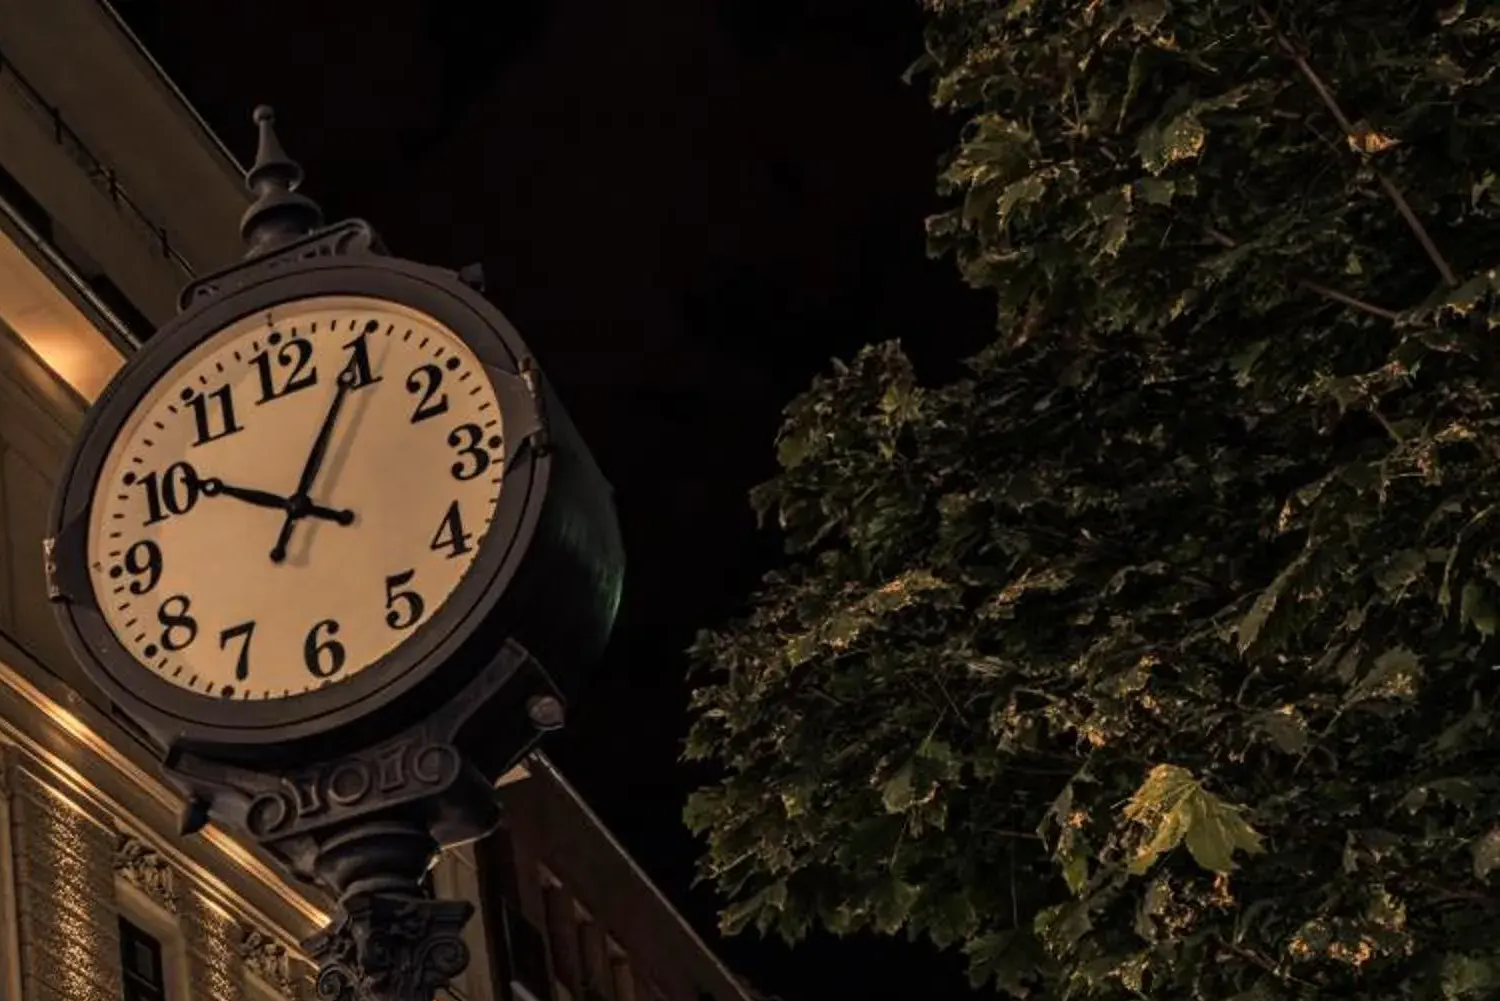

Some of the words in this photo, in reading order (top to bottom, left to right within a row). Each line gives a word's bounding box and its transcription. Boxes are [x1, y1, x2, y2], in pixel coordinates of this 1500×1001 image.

[249, 337, 319, 406] 12
[341, 335, 382, 390] 1
[183, 383, 245, 447] 11
[406, 363, 450, 424] 2
[448, 423, 490, 481] 3
[137, 461, 198, 527] 10
[431, 500, 473, 560] 4
[124, 540, 163, 596] 9
[156, 595, 197, 651] 8
[384, 569, 425, 630] 5
[220, 621, 257, 681] 7
[304, 620, 346, 678] 6
